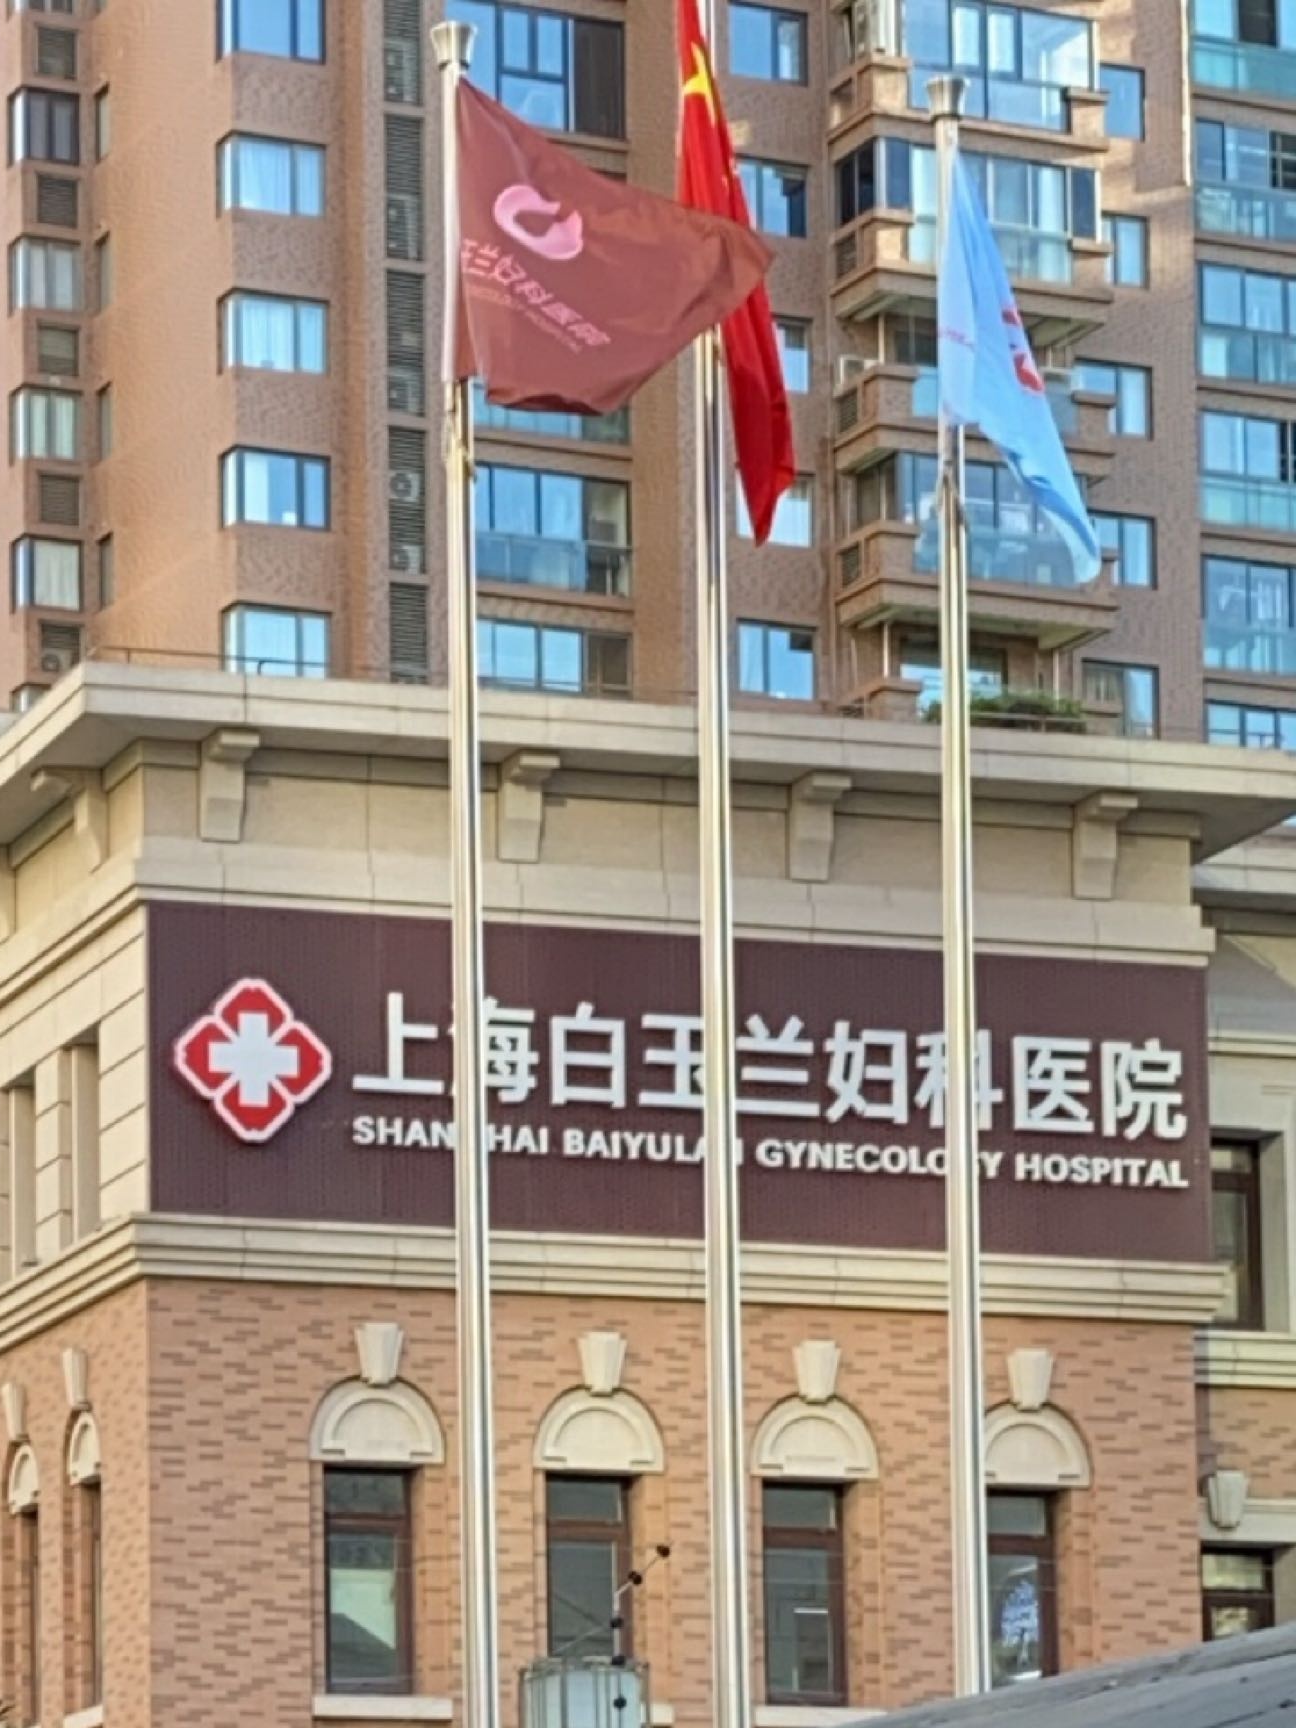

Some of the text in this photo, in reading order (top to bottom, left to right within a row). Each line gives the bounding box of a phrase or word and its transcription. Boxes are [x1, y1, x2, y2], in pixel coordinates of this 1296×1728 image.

[352, 992, 1188, 1141] 上海白玉兰妇科医院
[352, 1115, 1190, 1188] SHANHAI BAIYULA GYNECOLOY HOSPITAL
